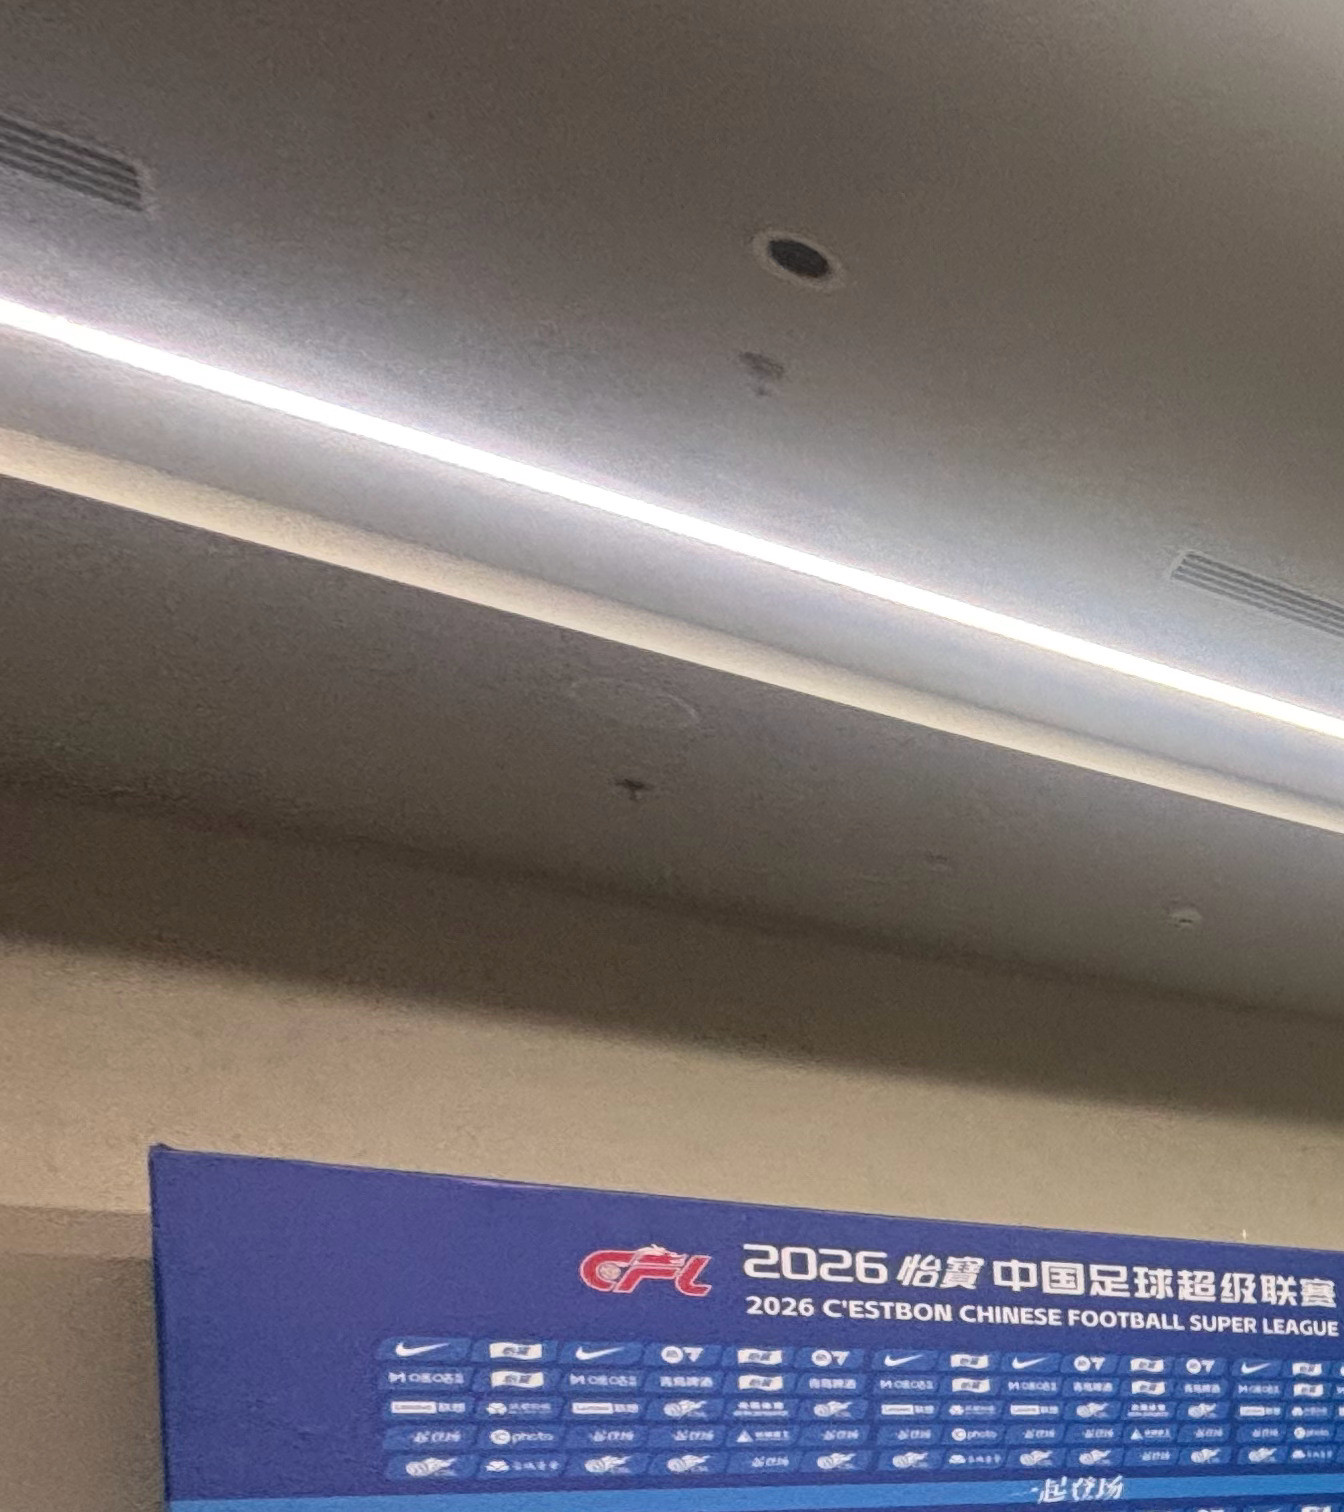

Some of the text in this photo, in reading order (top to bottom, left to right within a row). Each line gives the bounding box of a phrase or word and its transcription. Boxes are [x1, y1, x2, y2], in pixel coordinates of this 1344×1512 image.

[743, 1244, 888, 1284] 2026
[992, 1258, 1337, 1309] 中国足球超级联赛
[746, 1295, 1340, 1337] 2026 C'ESTBON CHINESE FOOTBALL SUPER LEAGUE
